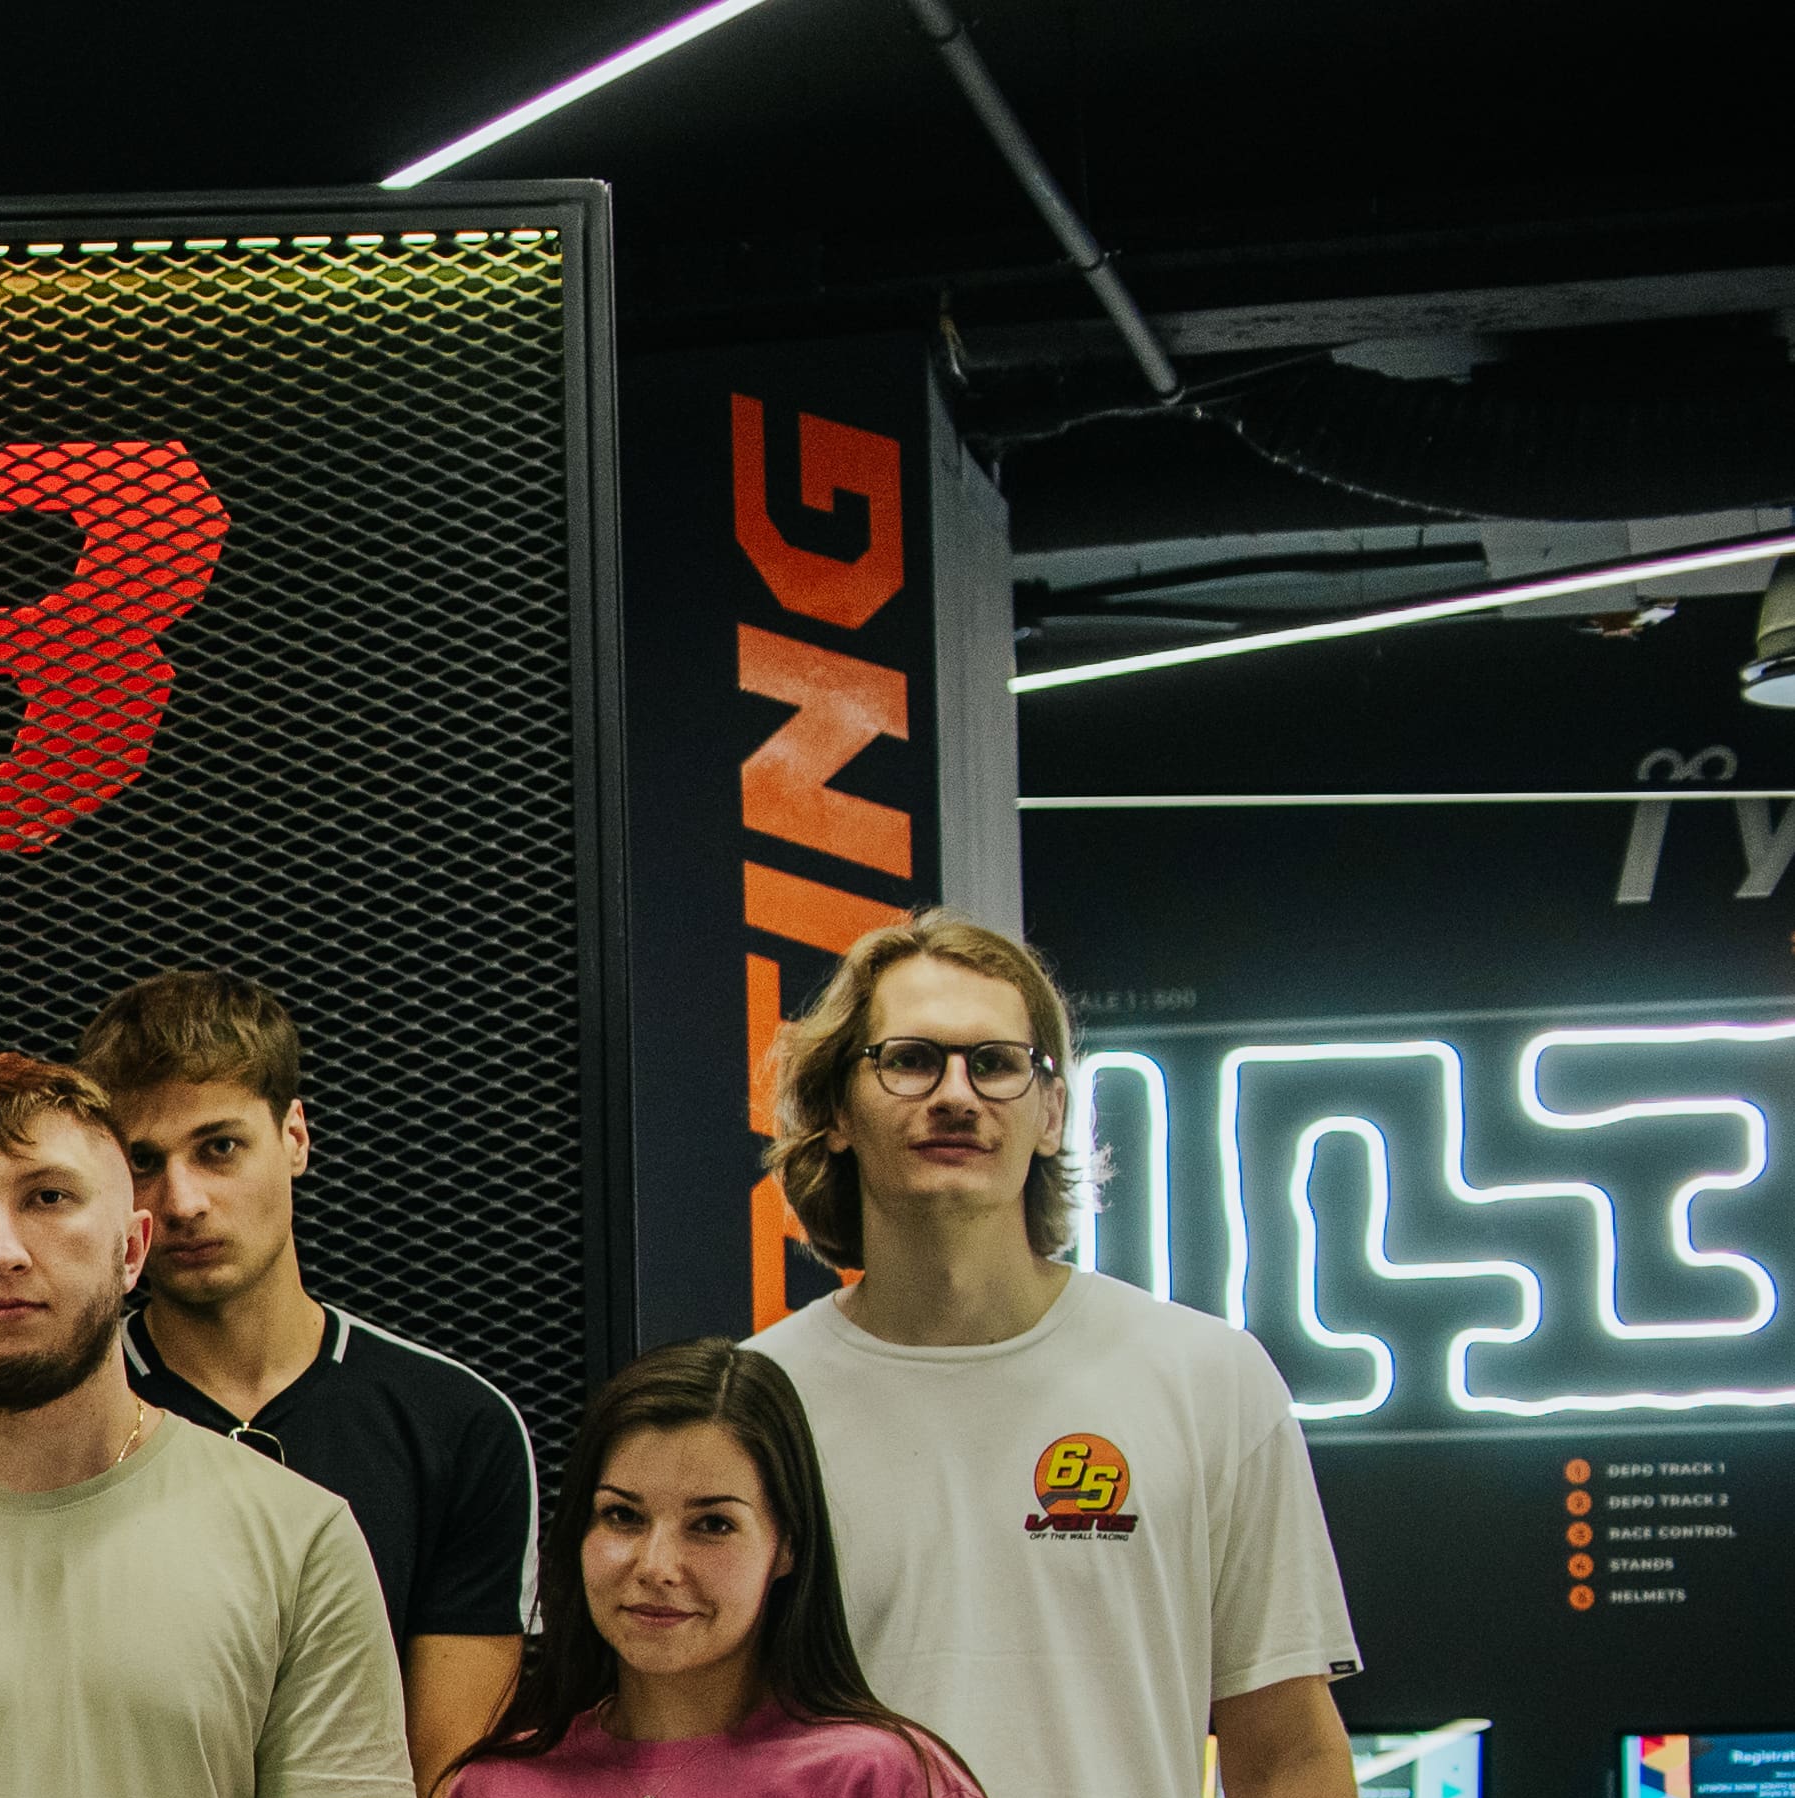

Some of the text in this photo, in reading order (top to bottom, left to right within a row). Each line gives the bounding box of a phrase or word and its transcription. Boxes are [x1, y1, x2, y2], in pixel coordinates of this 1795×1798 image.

[1608, 1463, 1655, 1478] DEPO
[1660, 1462, 1713, 1477] TRACK
[1718, 1462, 1726, 1475] 1
[1609, 1495, 1655, 1510] DEPO
[1660, 1493, 1714, 1508] TRACK
[1719, 1493, 1730, 1507] 2
[1029, 1532, 1129, 1542] OFF THE WALL RACING
[1609, 1526, 1653, 1541] RACE
[1659, 1524, 1736, 1540] CONTROL
[1609, 1557, 1675, 1573] STANDS
[1610, 1588, 1687, 1604] HELMETS
